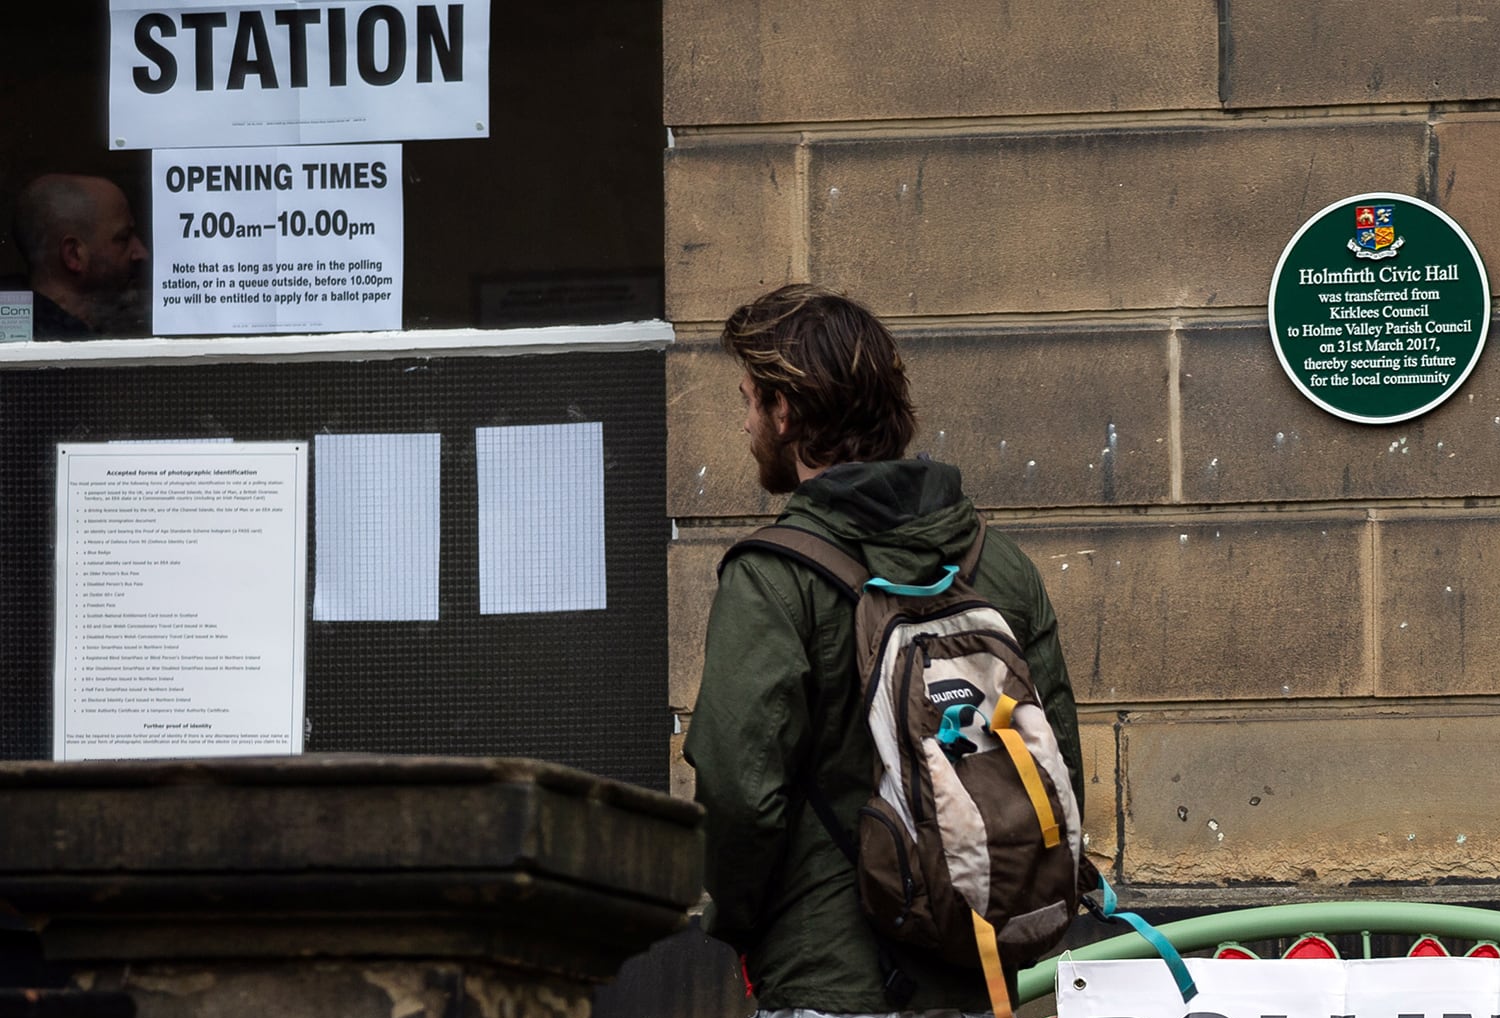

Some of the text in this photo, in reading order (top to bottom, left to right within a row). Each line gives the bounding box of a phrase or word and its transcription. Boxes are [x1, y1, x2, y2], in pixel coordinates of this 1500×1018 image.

[132, 4, 464, 94] STATION
[166, 161, 387, 193] OPENING TIMES
[172, 259, 382, 274] Note that as long as you are in the polling
[1298, 263, 1459, 284] Holmfirth Civic Hall
[162, 274, 392, 290] station, or in a queue outside, before 10.00pm
[163, 290, 391, 307] you will be entitled to apply for a ballot paper
[1317, 287, 1440, 303] was transferred from
[1329, 304, 1429, 319] Kirklees Council
[1287, 319, 1472, 337] to Holme Valley Parish Council
[1319, 337, 1440, 353] on 31st March 2017,
[1303, 354, 1456, 372] thereby securing its future
[1310, 370, 1450, 386] for the local community
